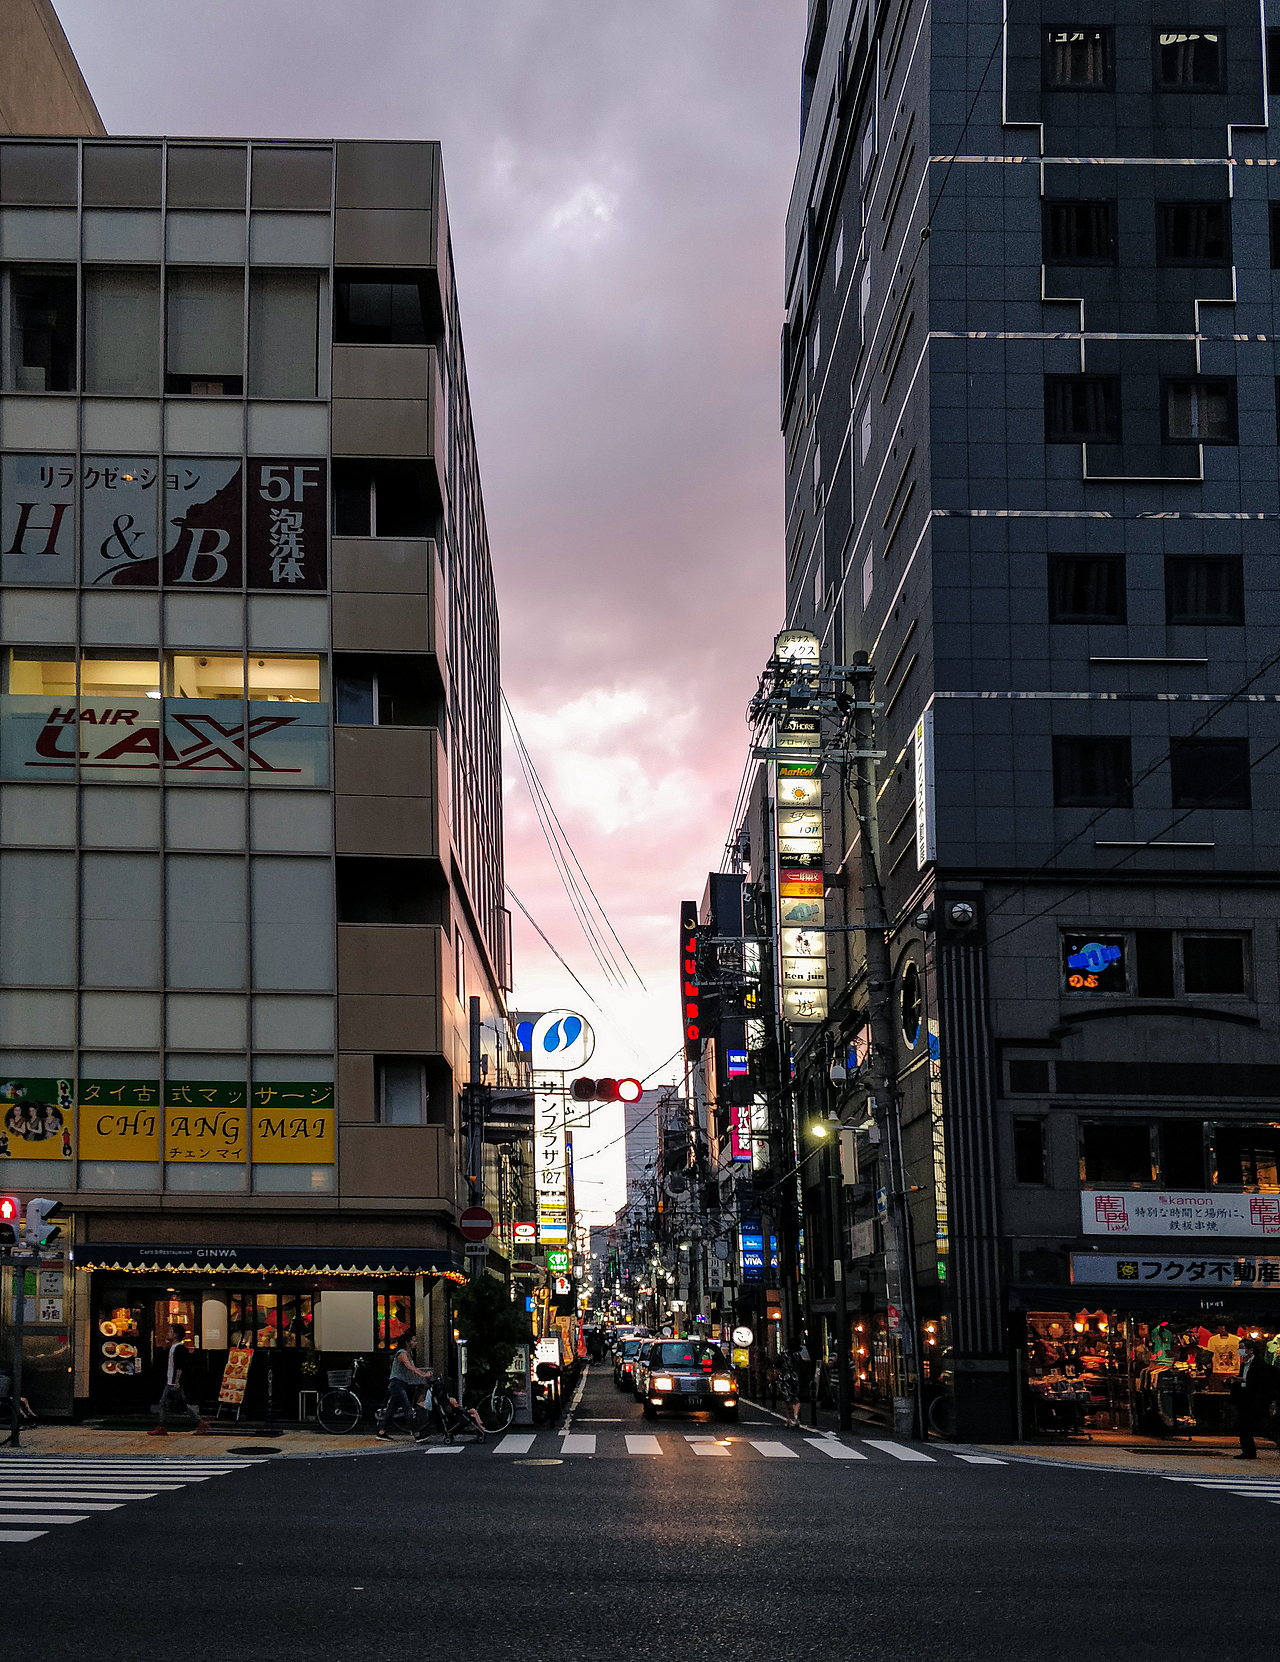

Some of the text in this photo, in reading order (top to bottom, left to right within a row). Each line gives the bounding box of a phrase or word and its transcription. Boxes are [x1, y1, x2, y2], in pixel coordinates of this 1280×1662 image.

[40, 466, 200, 490] リラクゼーション
[259, 466, 320, 502] 5F
[4, 502, 231, 583] H & B
[270, 508, 305, 584] 泡洗体
[780, 646, 816, 656] マクス
[46, 708, 139, 725] HAIR
[785, 971, 825, 982] ken jun
[84, 1083, 333, 1105] タイ古式マッサージ
[258, 1118, 326, 1139] MAI
[541, 1081, 560, 1167] サンプラザ
[541, 1172, 561, 1185] 127
[1169, 1195, 1213, 1206] kamon
[1135, 1207, 1245, 1220] 特別な時間と場所に、
[1169, 1220, 1219, 1232] 鉄板串焼
[196, 1249, 238, 1258] GINWA
[744, 1257, 764, 1267] VIVA
[1141, 1260, 1280, 1282] フクダ不動産
